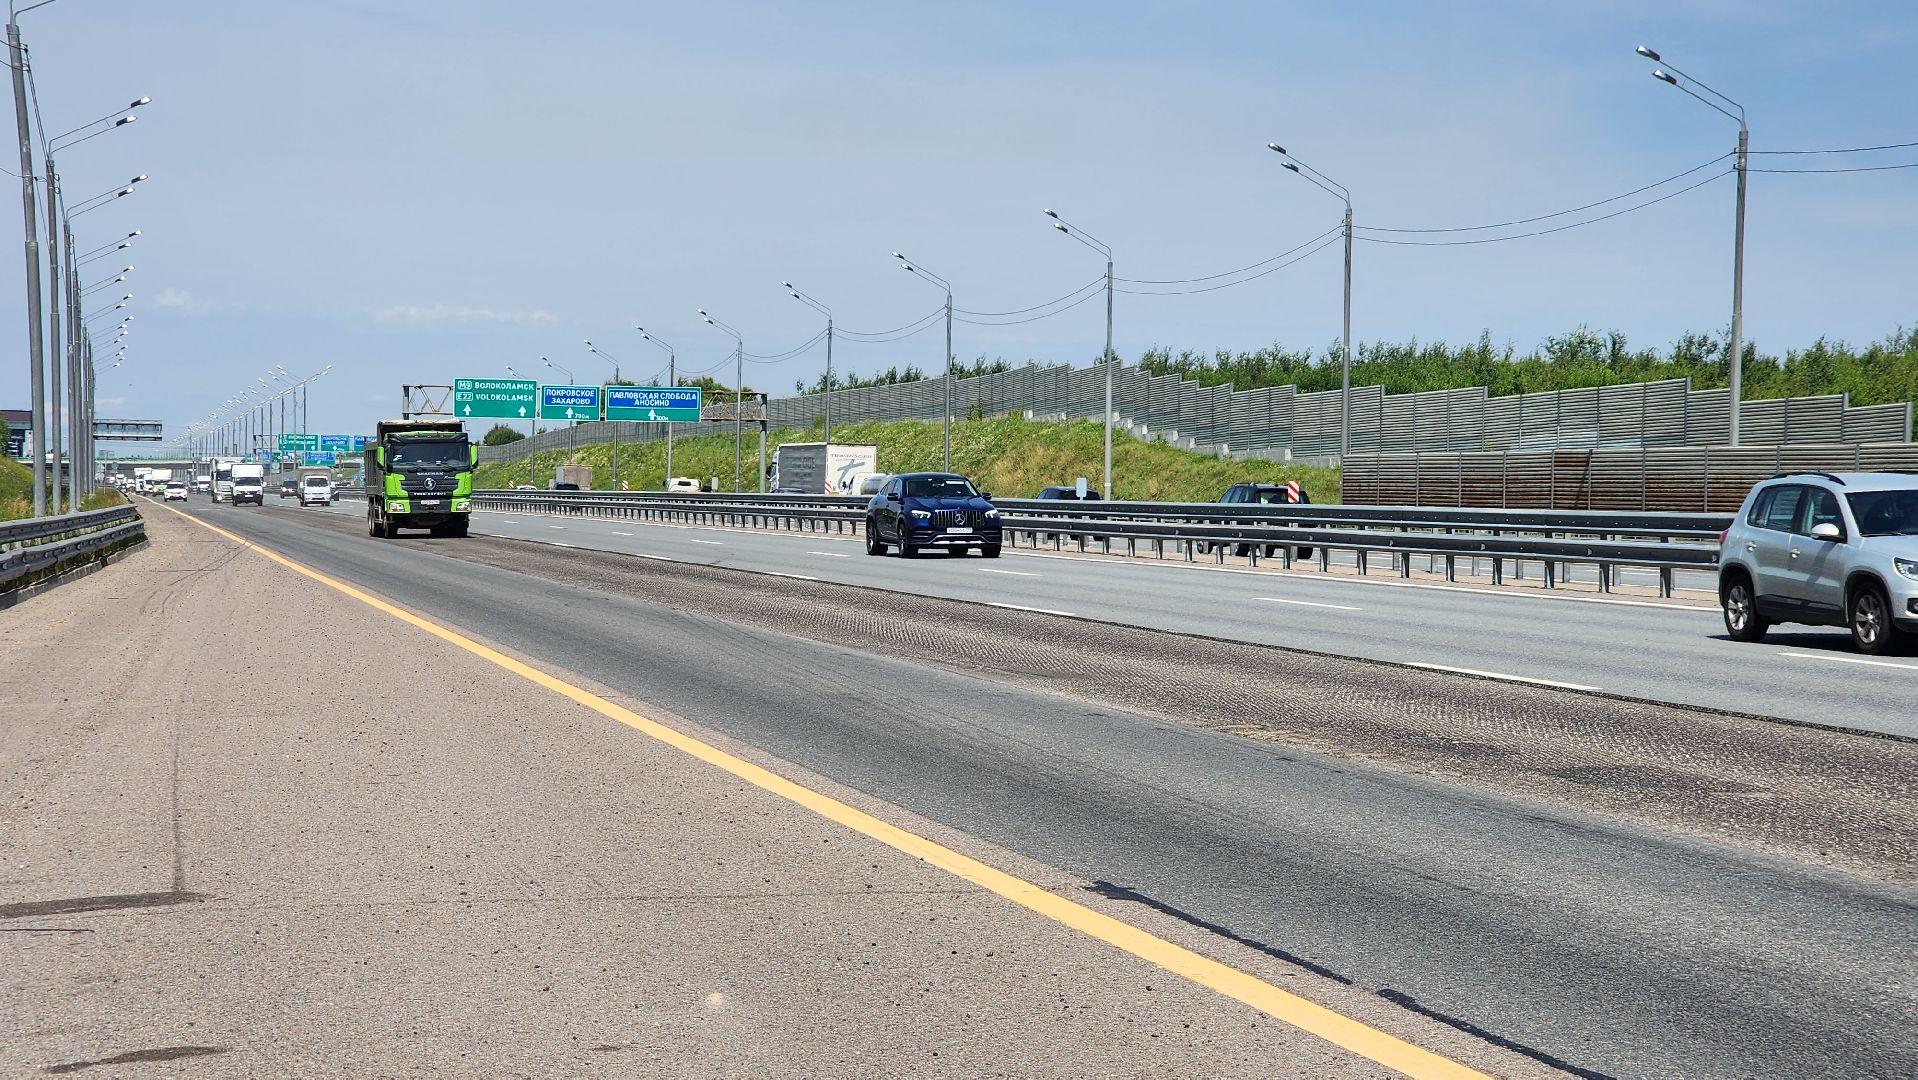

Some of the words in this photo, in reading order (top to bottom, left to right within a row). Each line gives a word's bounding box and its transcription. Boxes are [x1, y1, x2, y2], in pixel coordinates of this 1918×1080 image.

[474, 382, 535, 390] ВОЛОКОЛАМСК
[546, 389, 595, 397] ПОКРОВСКОЕ
[609, 391, 659, 400] ПАВЛОВСКАЯ
[659, 392, 697, 401] СЛОБОДА
[475, 393, 534, 402] VOLOKOLAMSK
[551, 397, 591, 405] ЗАХАРОВО
